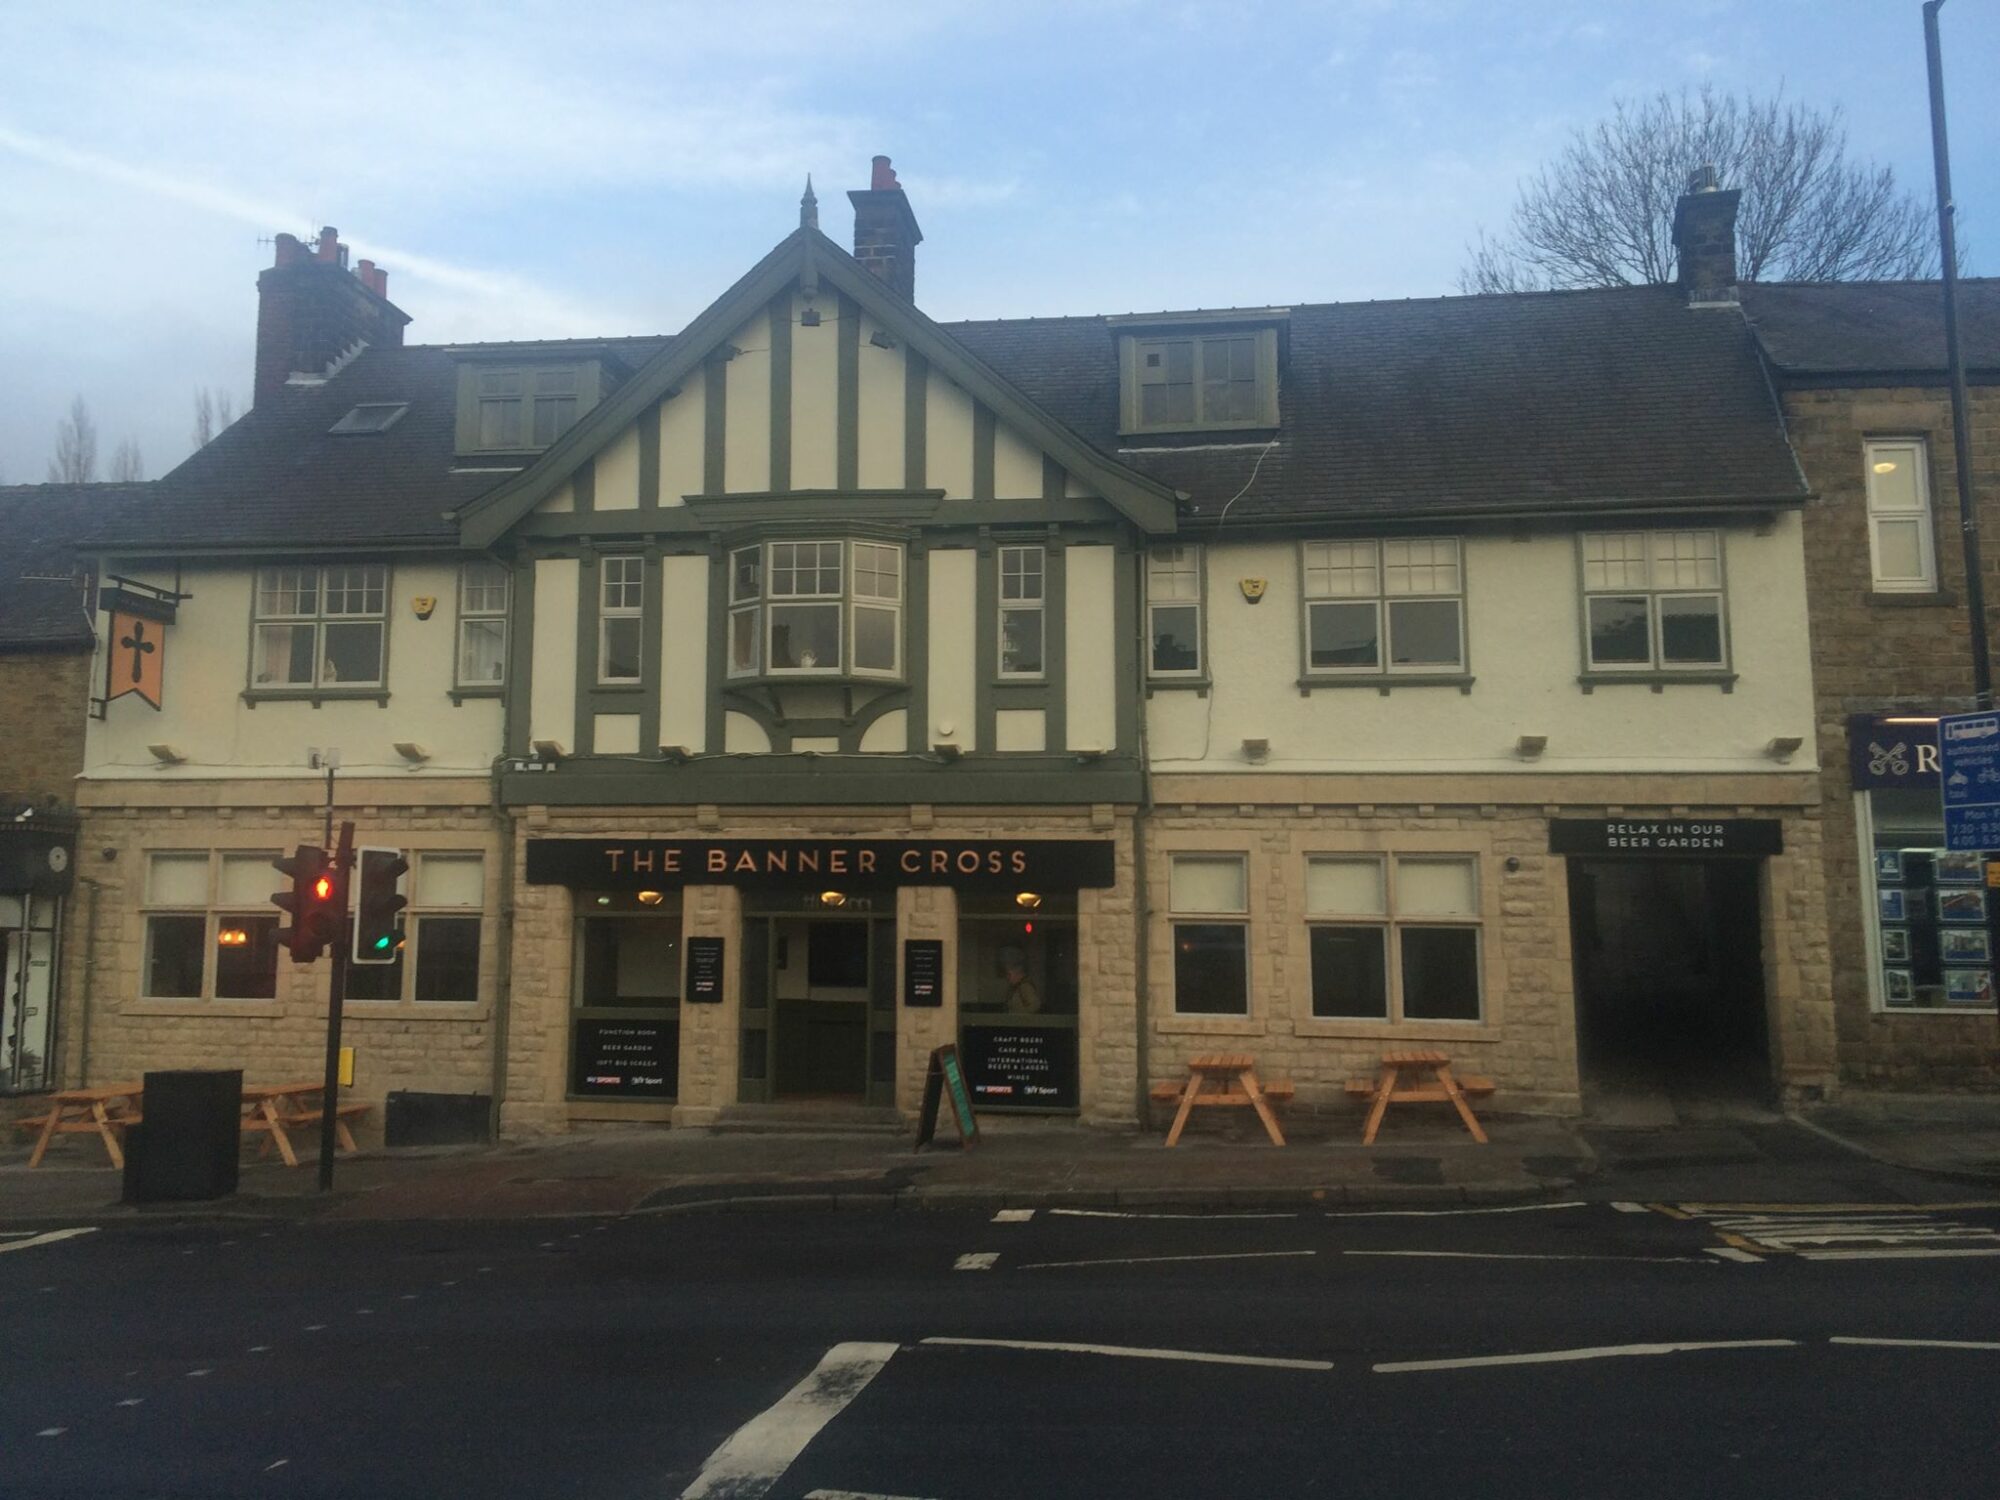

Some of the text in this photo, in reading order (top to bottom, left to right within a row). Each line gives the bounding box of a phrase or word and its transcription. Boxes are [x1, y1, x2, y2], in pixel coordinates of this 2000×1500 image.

[1607, 824, 1725, 835] RELAX IN OUR
[1608, 838, 1725, 848] BEER GARDEN
[605, 849, 1027, 875] THE BANNER CROSS
[986, 1085, 1013, 1093] SPORTS
[1039, 1086, 1058, 1095] Sport
